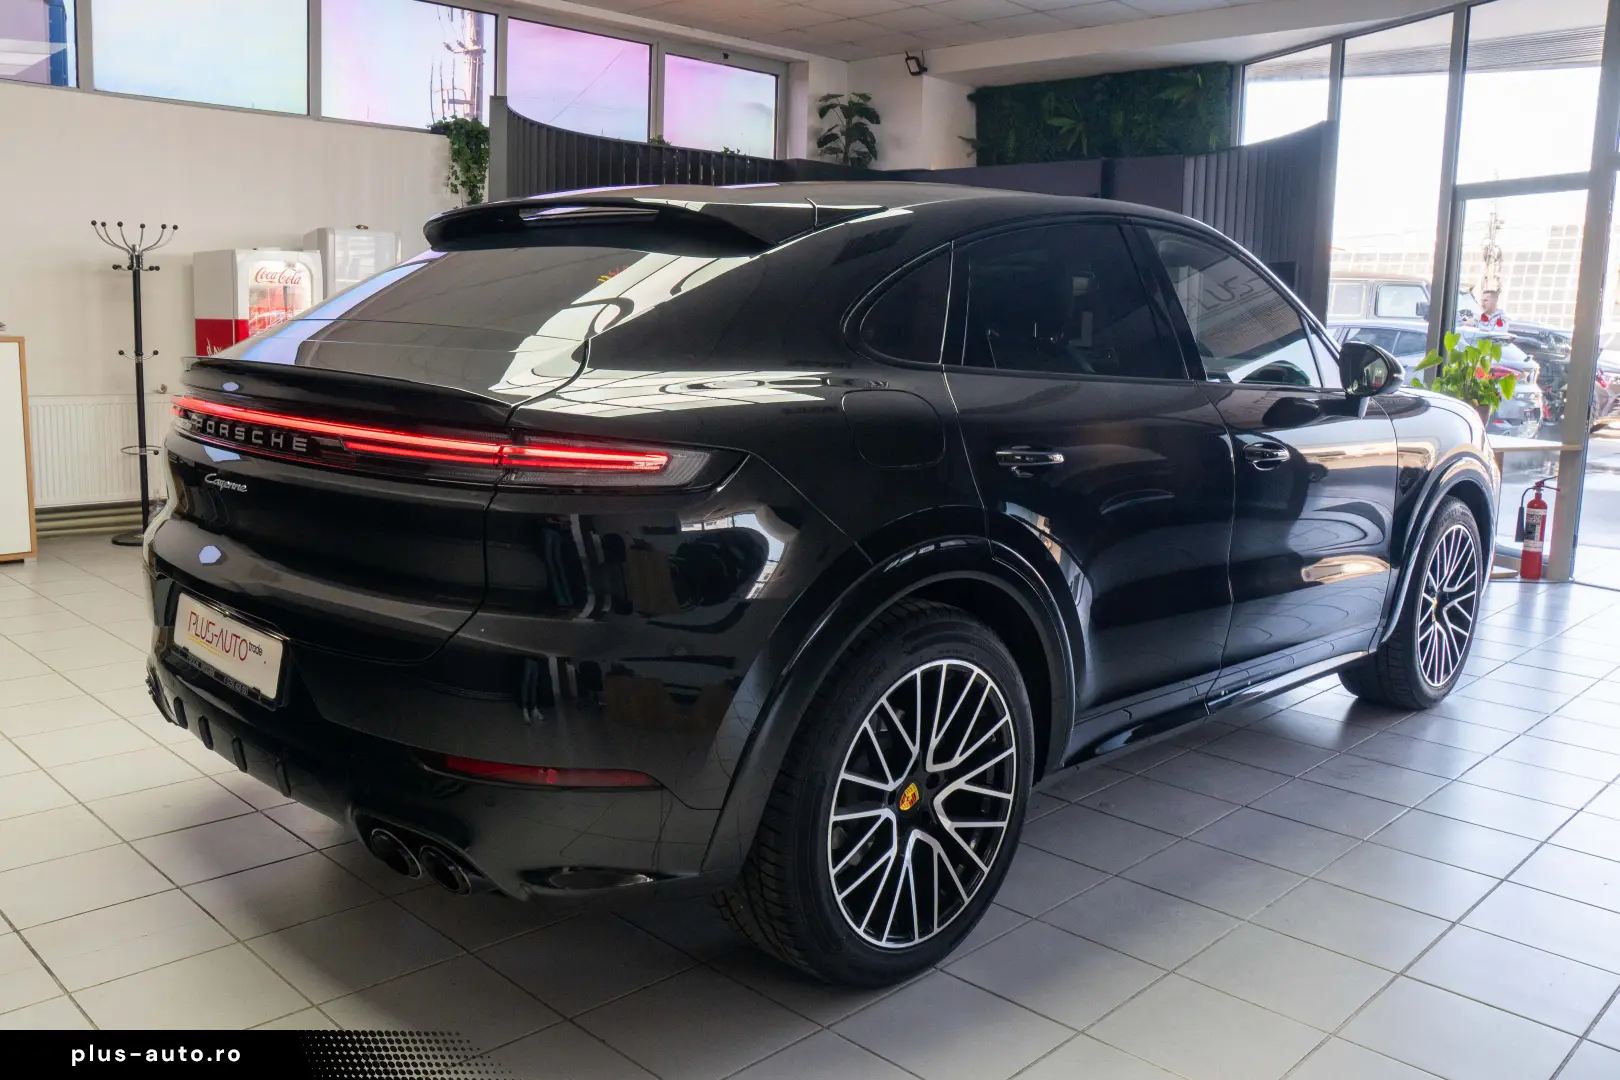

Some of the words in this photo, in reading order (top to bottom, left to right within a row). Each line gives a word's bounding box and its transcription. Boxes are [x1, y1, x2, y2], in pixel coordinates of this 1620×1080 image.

[194, 417, 308, 452] PORSCHE
[204, 473, 248, 492] Cayenne
[187, 611, 249, 661] PLUS-AUTO
